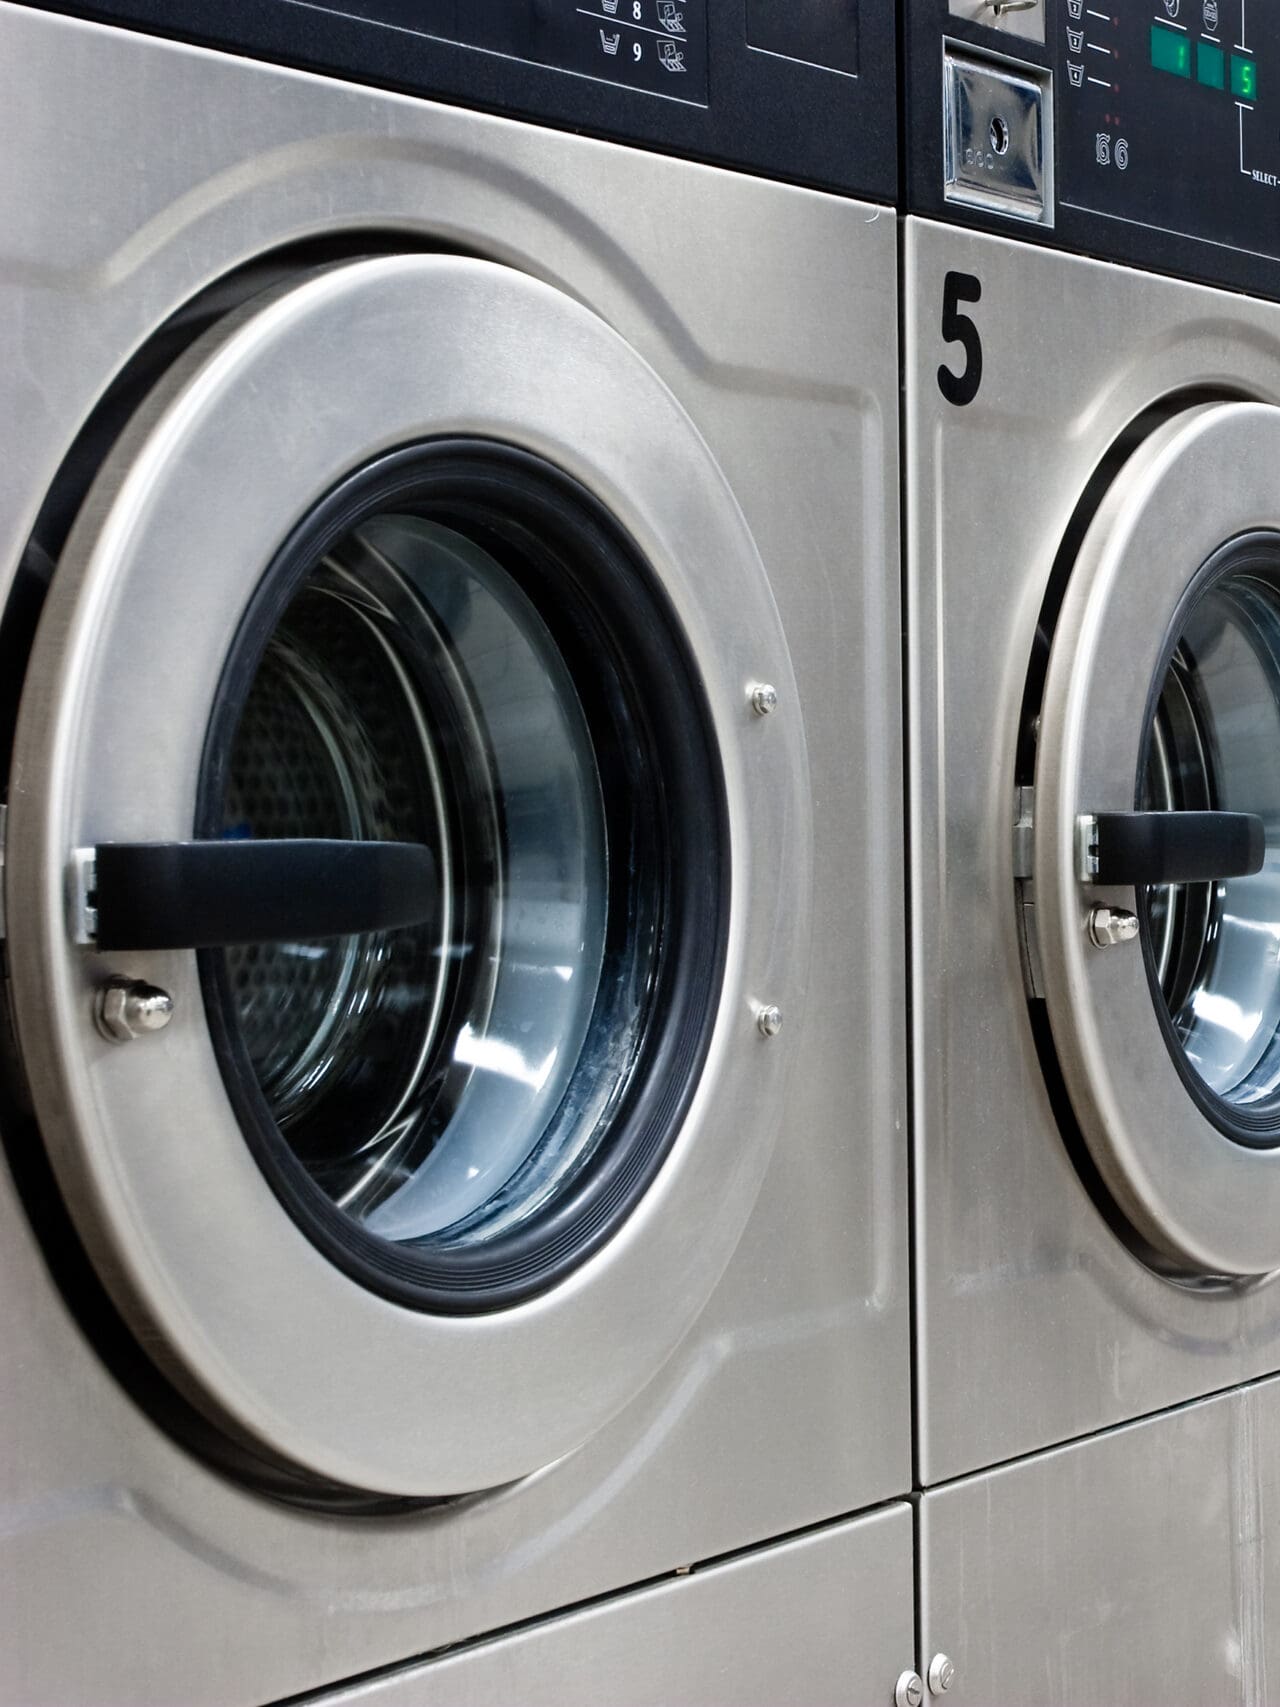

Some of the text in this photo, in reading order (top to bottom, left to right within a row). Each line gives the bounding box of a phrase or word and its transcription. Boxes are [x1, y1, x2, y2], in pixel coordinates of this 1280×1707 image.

[633, 1, 642, 20] 8
[633, 42, 642, 61] 9
[1241, 66, 1251, 93] 5
[1252, 169, 1278, 187] SELECT
[937, 271, 983, 407] 5
